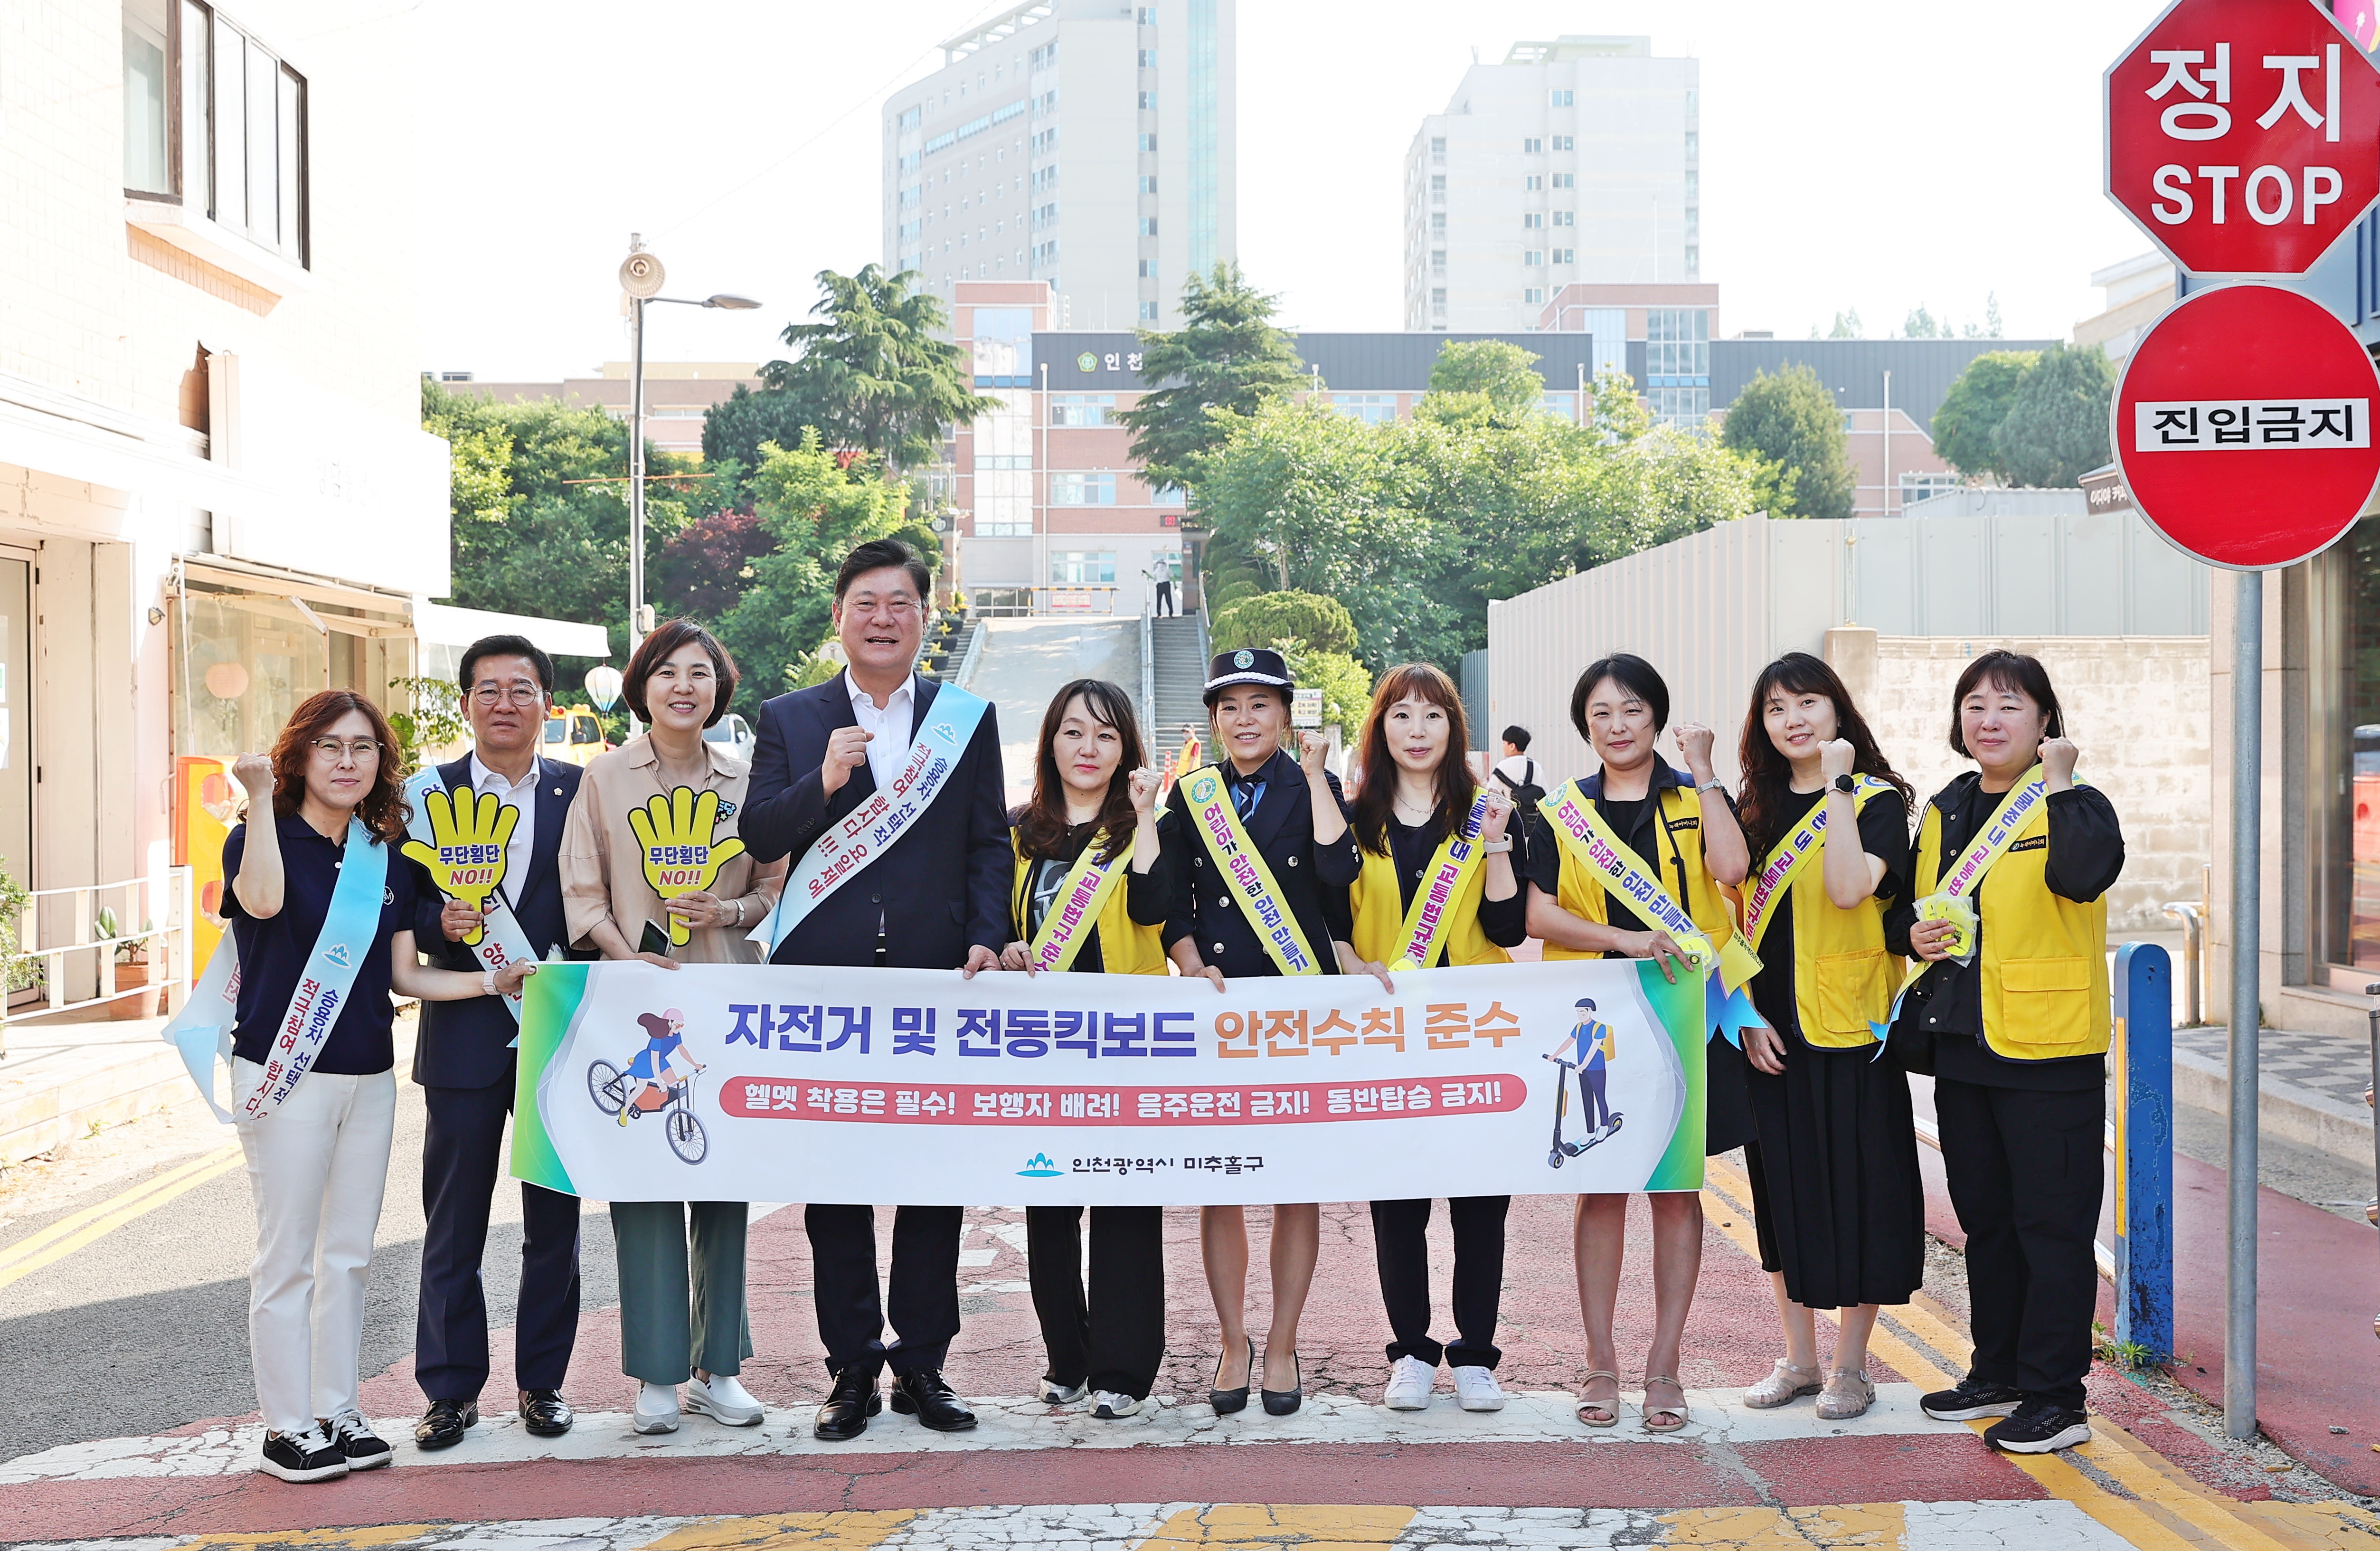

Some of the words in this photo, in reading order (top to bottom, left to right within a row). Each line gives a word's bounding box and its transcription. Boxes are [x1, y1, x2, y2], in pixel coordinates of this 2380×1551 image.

[2151, 163, 2343, 226] STOP
[2152, 404, 2353, 444] 진입금지
[2090, 486, 2111, 506] 이디야
[892, 741, 933, 799] 적극참여
[916, 756, 948, 802] 승용차
[842, 795, 890, 840] 합시다
[873, 801, 917, 847] 선택적
[2002, 780, 2047, 828] 스쿨존
[439, 845, 500, 865] 무단횡단
[649, 846, 708, 865] 무단횡단
[1450, 841, 1472, 862] 내
[1794, 830, 1814, 853] 내
[1987, 825, 2008, 847] 내
[450, 869, 493, 886] NO!!
[659, 870, 700, 885] NO!!
[808, 843, 869, 899] 요일제에
[1203, 802, 1238, 856] 어린이가
[1229, 853, 1264, 898] 안전한
[1254, 895, 1283, 929] 인천
[1271, 926, 1309, 972] 만들기
[1558, 800, 1595, 845] 어린이가
[1589, 838, 1627, 879] 안전한
[1622, 870, 1657, 902] 인천
[1647, 894, 1695, 935] 만들기
[1947, 844, 1990, 897] 교통법
[1052, 870, 1101, 943] 교통법규
[1733, 932, 1763, 968] 미추홀녹색어머니회
[280, 977, 321, 1055] 적극참여
[305, 988, 339, 1045] 승용차
[725, 1004, 871, 1054] 자전거
[893, 1008, 936, 1056] 및
[957, 1009, 1197, 1059] 전동킥보드
[1215, 1007, 1405, 1058] 안전수칙
[1424, 1002, 1521, 1049] 준수
[245, 1059, 284, 1117] 합시다
[273, 1051, 312, 1106] 선택적
[745, 1083, 798, 1113] 헬멧
[807, 1087, 886, 1115] 착용은
[896, 1090, 955, 1116] 필수!
[973, 1092, 1052, 1118] 보행자
[1060, 1093, 1120, 1118] 배려!
[1137, 1092, 1241, 1118] 음주운전
[1250, 1090, 1310, 1116] 금지!
[1327, 1084, 1432, 1114] 동반탑승
[1441, 1081, 1502, 1107] 금지!
[1073, 1157, 1175, 1175] 인천광역시
[1184, 1155, 1264, 1174] 미추홀구
